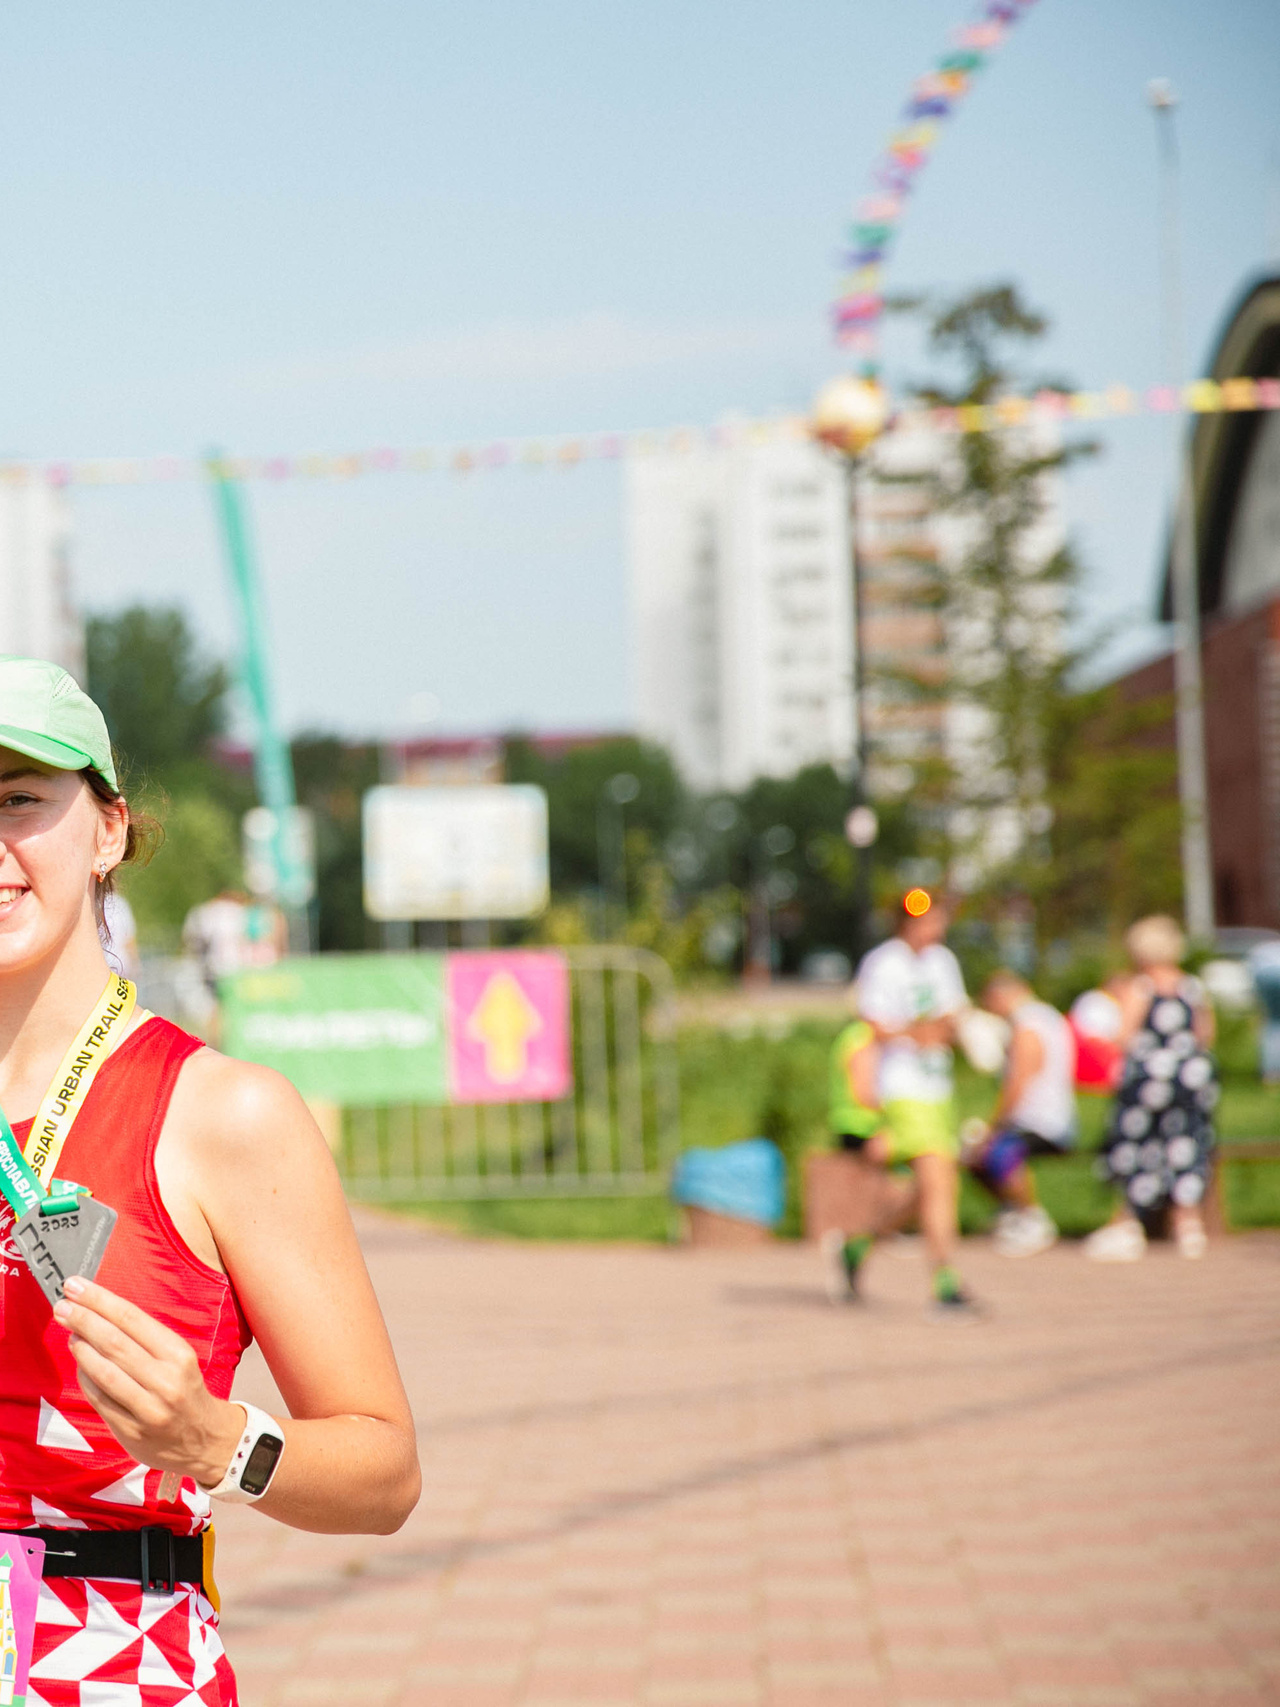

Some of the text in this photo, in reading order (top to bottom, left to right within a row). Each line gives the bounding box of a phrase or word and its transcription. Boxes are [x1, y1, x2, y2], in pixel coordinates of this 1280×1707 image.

[31, 1119, 58, 1178] SSIAN
[51, 1050, 93, 1117] URBAN
[85, 1002, 123, 1049] TRAIL
[41, 1215, 79, 1232] 2023
